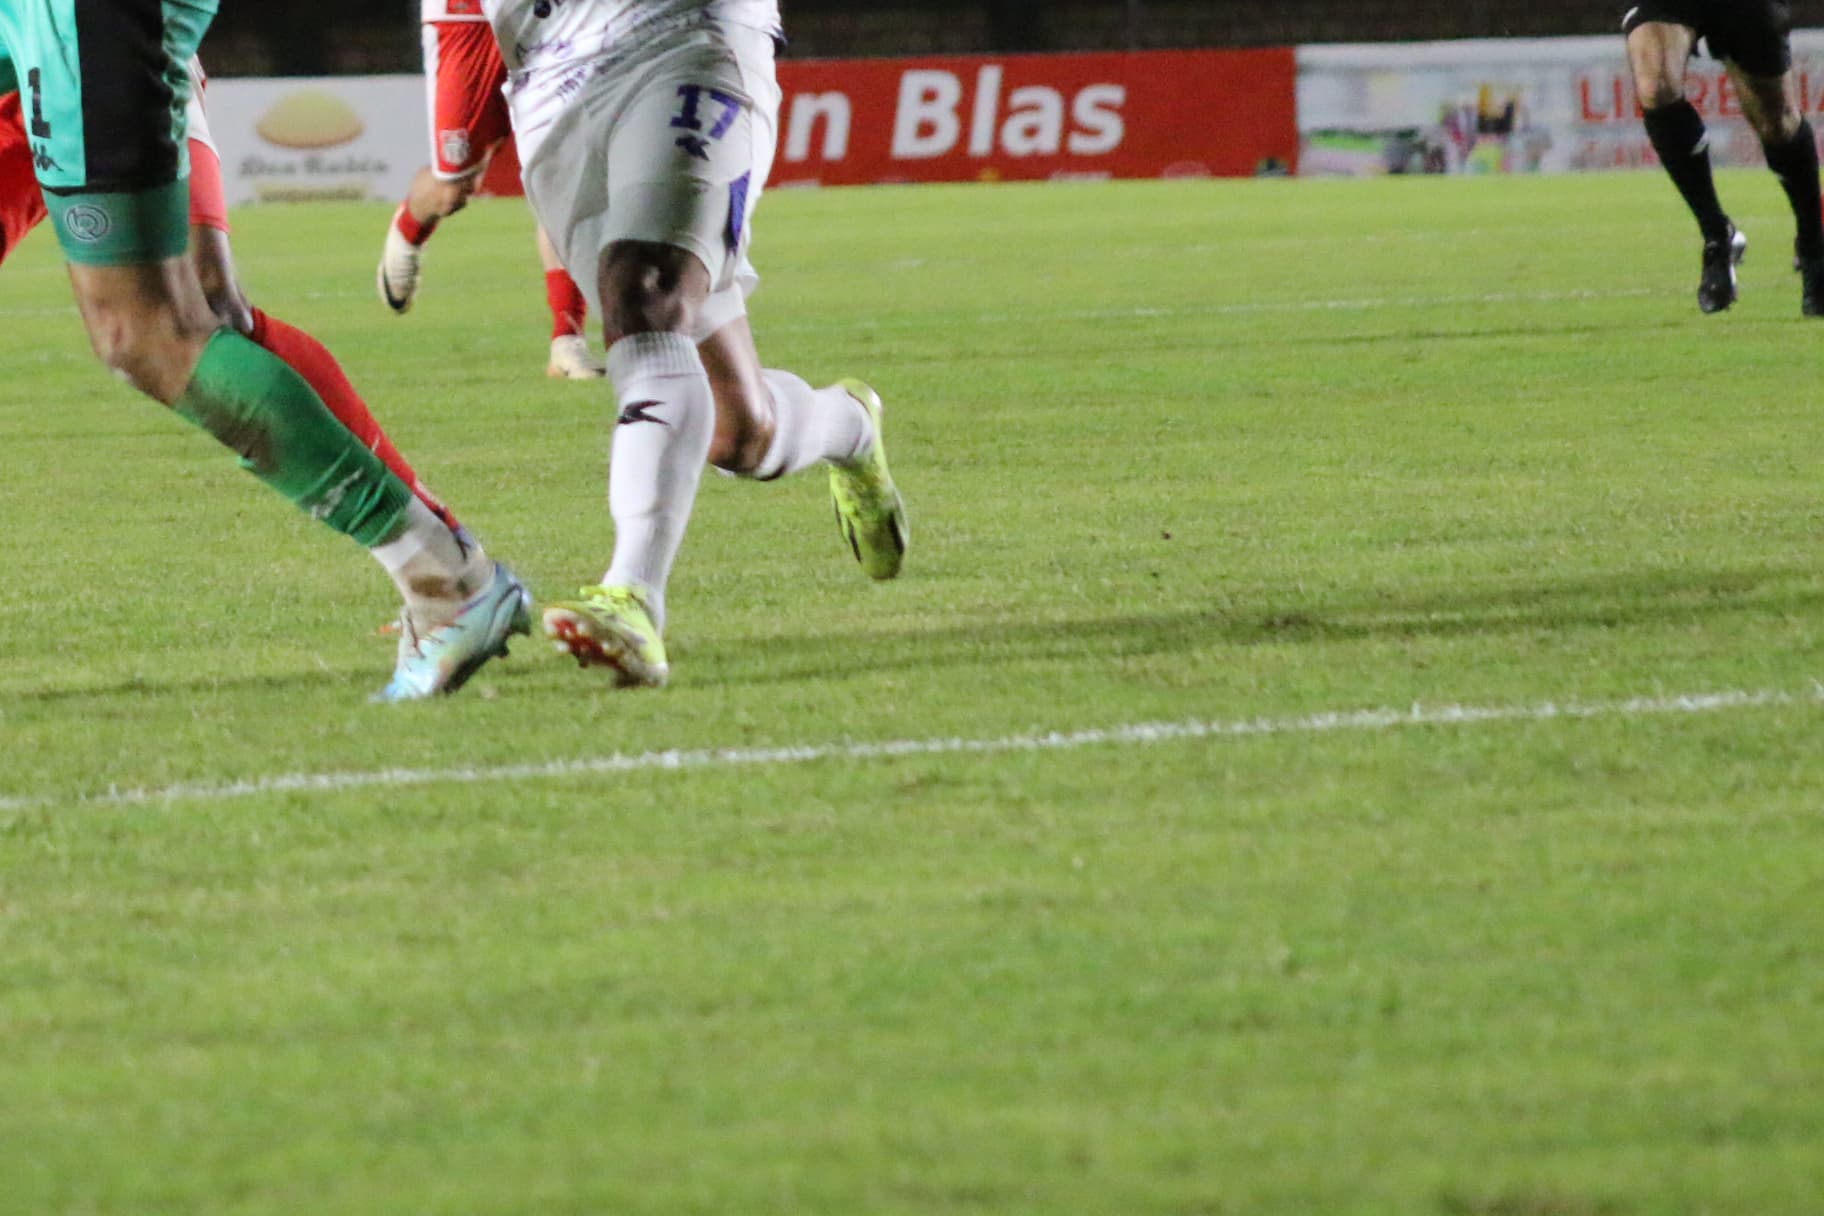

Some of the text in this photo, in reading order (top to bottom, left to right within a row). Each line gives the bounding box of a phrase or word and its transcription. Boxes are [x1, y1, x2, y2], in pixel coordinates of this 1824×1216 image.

[28, 67, 52, 139] 1
[669, 85, 740, 140] 17
[889, 64, 1127, 159] Blas
